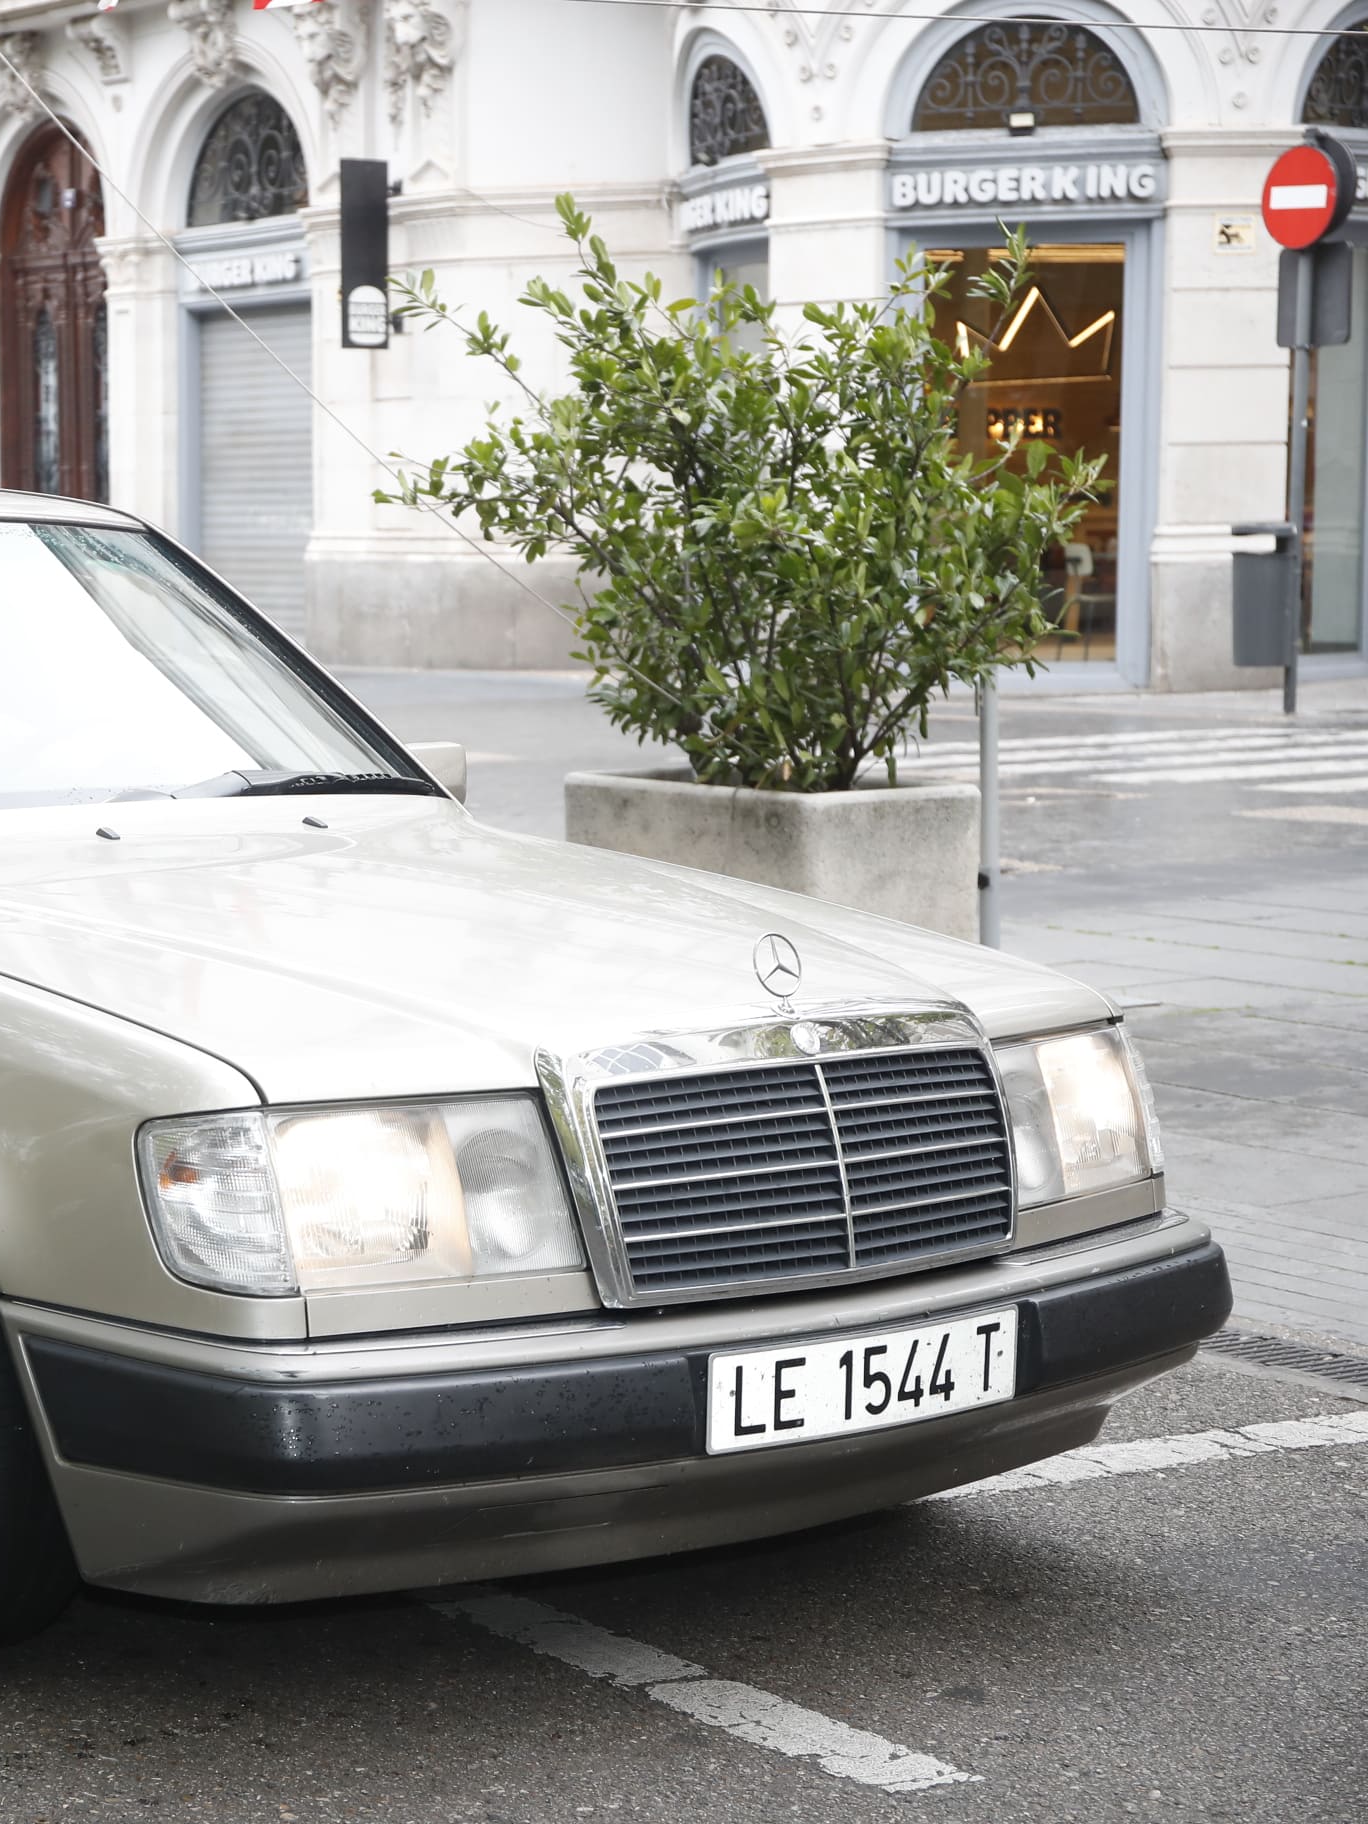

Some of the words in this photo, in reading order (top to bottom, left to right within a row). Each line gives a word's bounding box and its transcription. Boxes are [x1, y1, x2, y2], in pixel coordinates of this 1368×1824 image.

[714, 185, 768, 225] KING
[891, 168, 1045, 208] BURGER
[1051, 164, 1156, 200] KING
[734, 1357, 806, 1436] LE
[839, 1333, 955, 1420] 1544
[976, 1322, 1001, 1392] T
